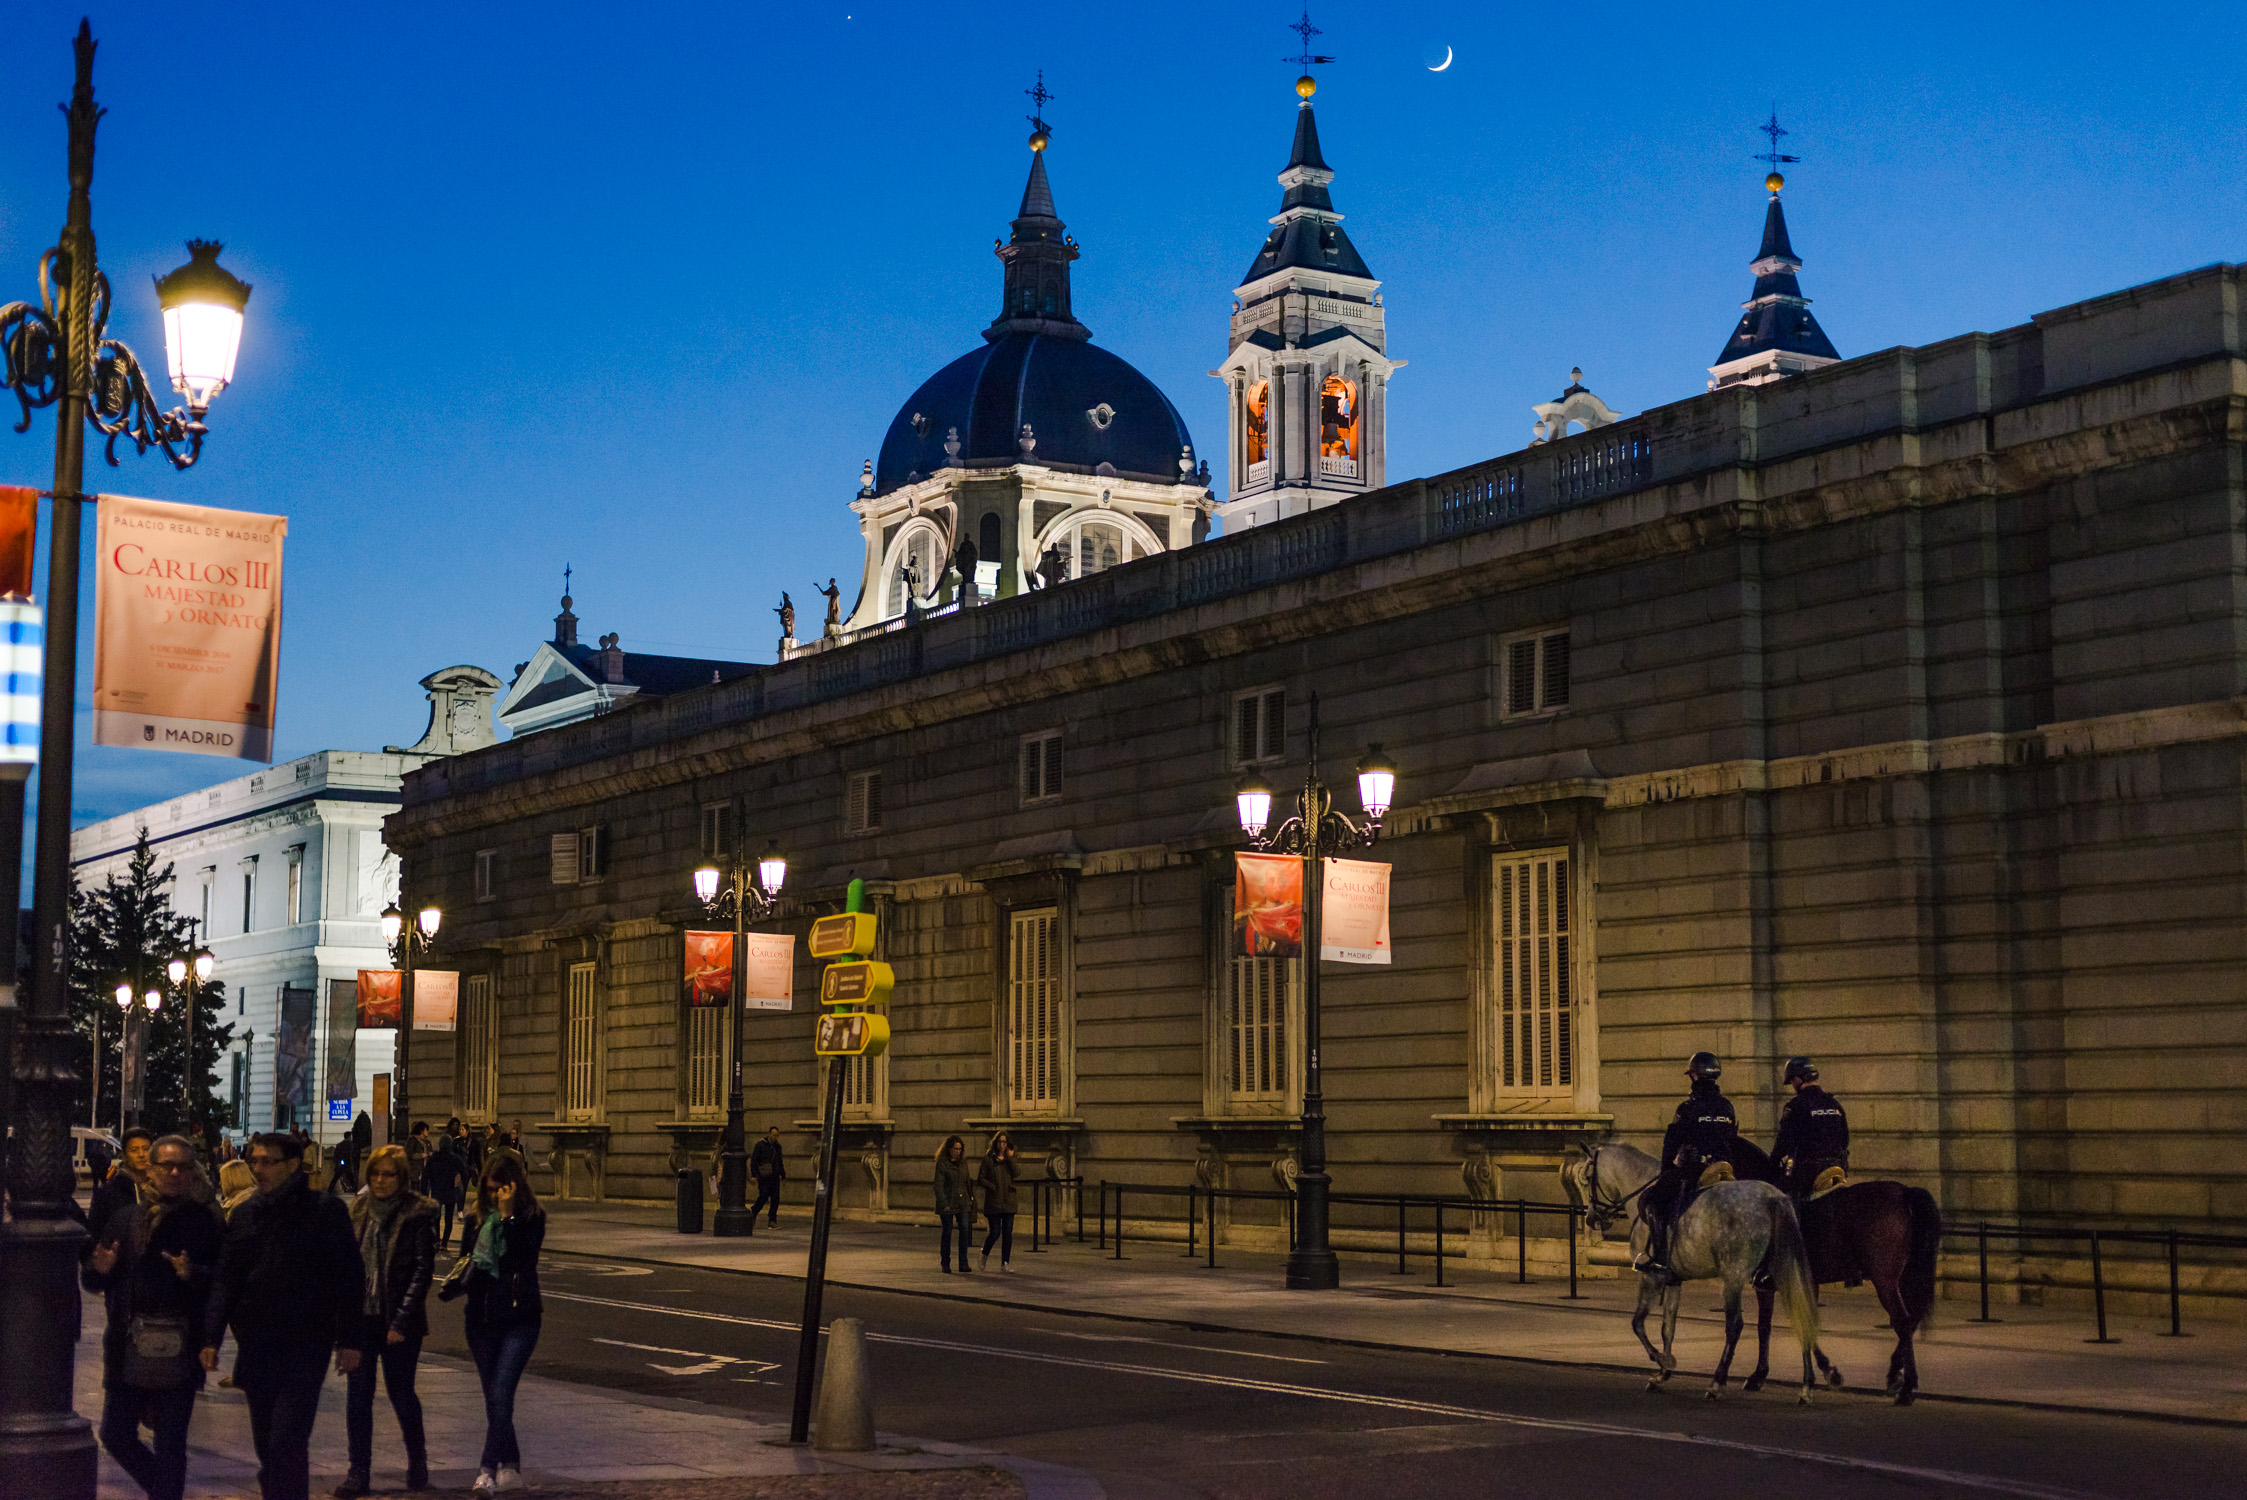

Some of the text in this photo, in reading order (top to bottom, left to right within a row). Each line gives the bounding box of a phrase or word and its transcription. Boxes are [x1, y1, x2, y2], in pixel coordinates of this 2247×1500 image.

[113, 516, 271, 544] PALACIO REAL DE MADRID
[113, 543, 270, 590] CARLOS III
[144, 584, 245, 609] MAJESTAD
[180, 607, 268, 630] ORNATO
[165, 728, 234, 747] MADRID
[1329, 876, 1385, 895] CARLOS III
[1340, 893, 1377, 903] MAJESTAD
[1354, 902, 1385, 912] ORNATO
[1347, 952, 1372, 960] MADRID
[1811, 1108, 1841, 1117] POLICIA
